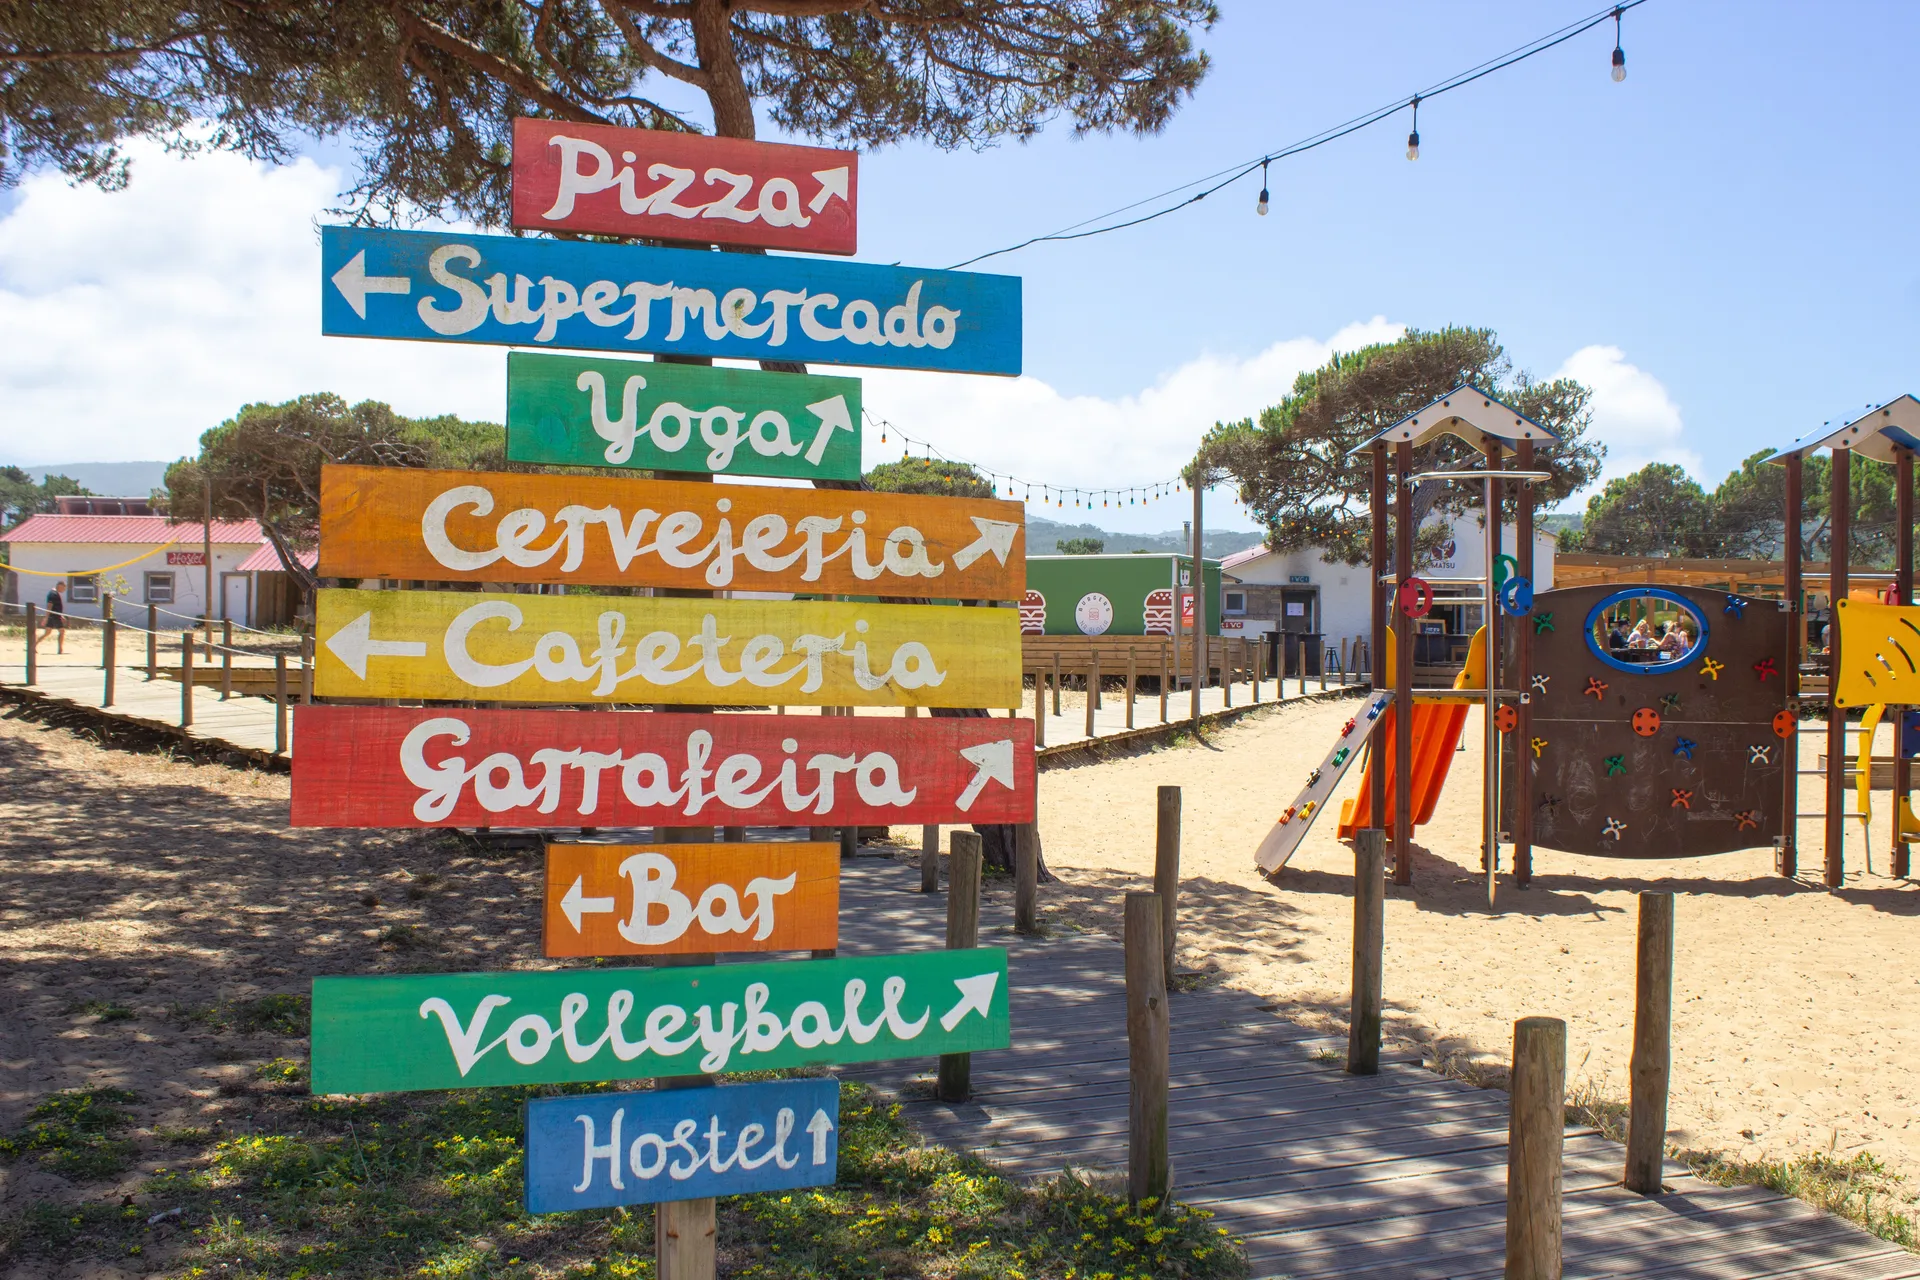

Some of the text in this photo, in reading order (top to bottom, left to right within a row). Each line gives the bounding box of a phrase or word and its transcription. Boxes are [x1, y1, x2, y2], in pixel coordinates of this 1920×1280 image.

[541, 135, 811, 229] Pizza
[417, 244, 961, 350] Supermercado
[577, 370, 804, 472] Yoga
[169, 552, 205, 565] Hostel
[422, 485, 944, 588] Cervejeria
[444, 601, 946, 697] Cafeteria
[1078, 595, 1111, 612] BURGERS
[399, 717, 917, 823] Garrafeira
[617, 852, 797, 946] Bar
[419, 975, 930, 1078] Volleyball
[573, 1107, 800, 1193] Hostel
